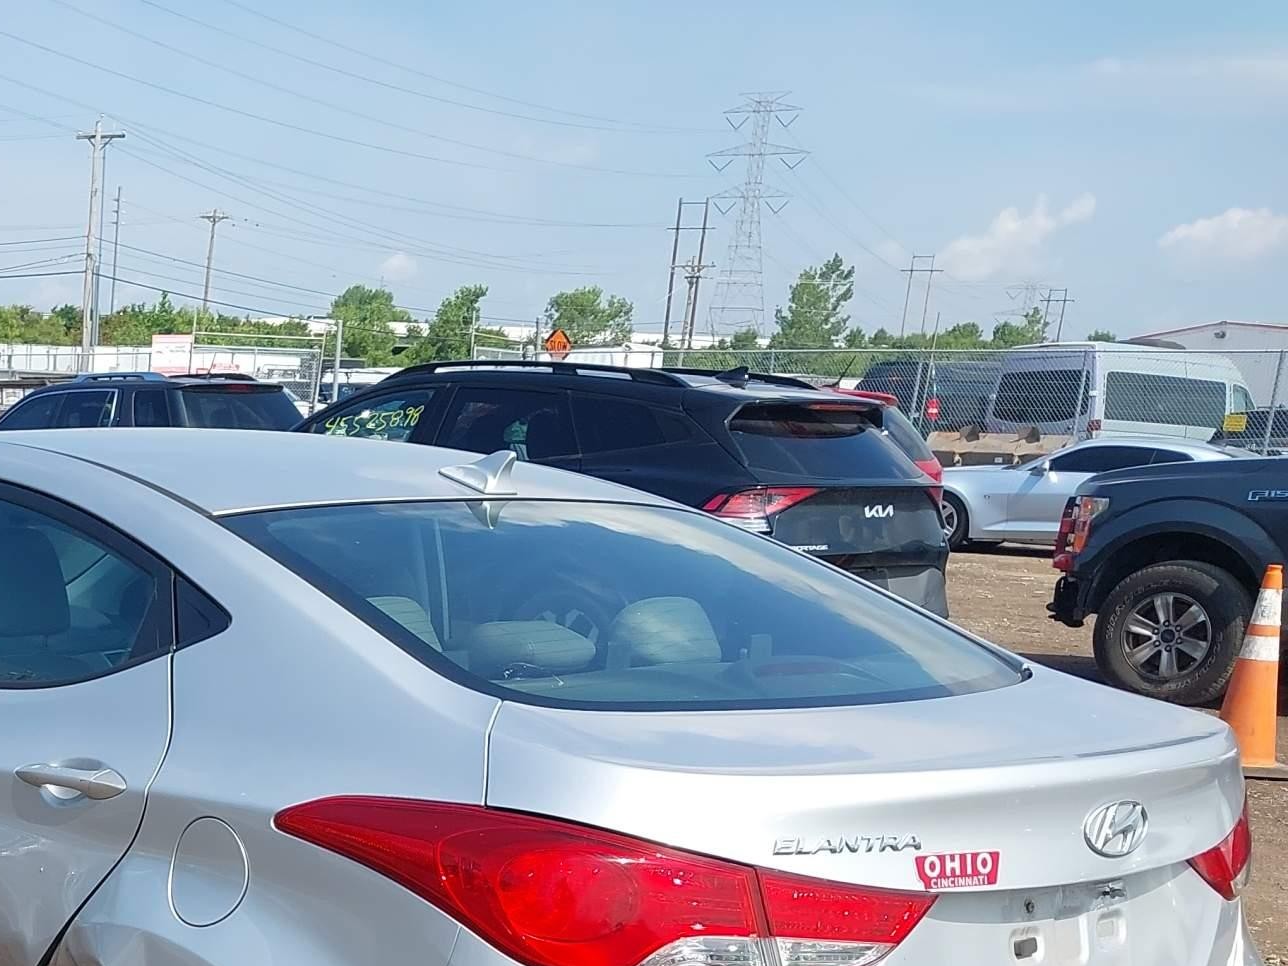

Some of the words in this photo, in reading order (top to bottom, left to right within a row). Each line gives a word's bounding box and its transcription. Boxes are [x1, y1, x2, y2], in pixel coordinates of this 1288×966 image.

[864, 504, 894, 518] KIA
[773, 834, 923, 856] ELANTRA
[924, 852, 993, 878] OHIO
[930, 875, 988, 889] CINCINNATI
